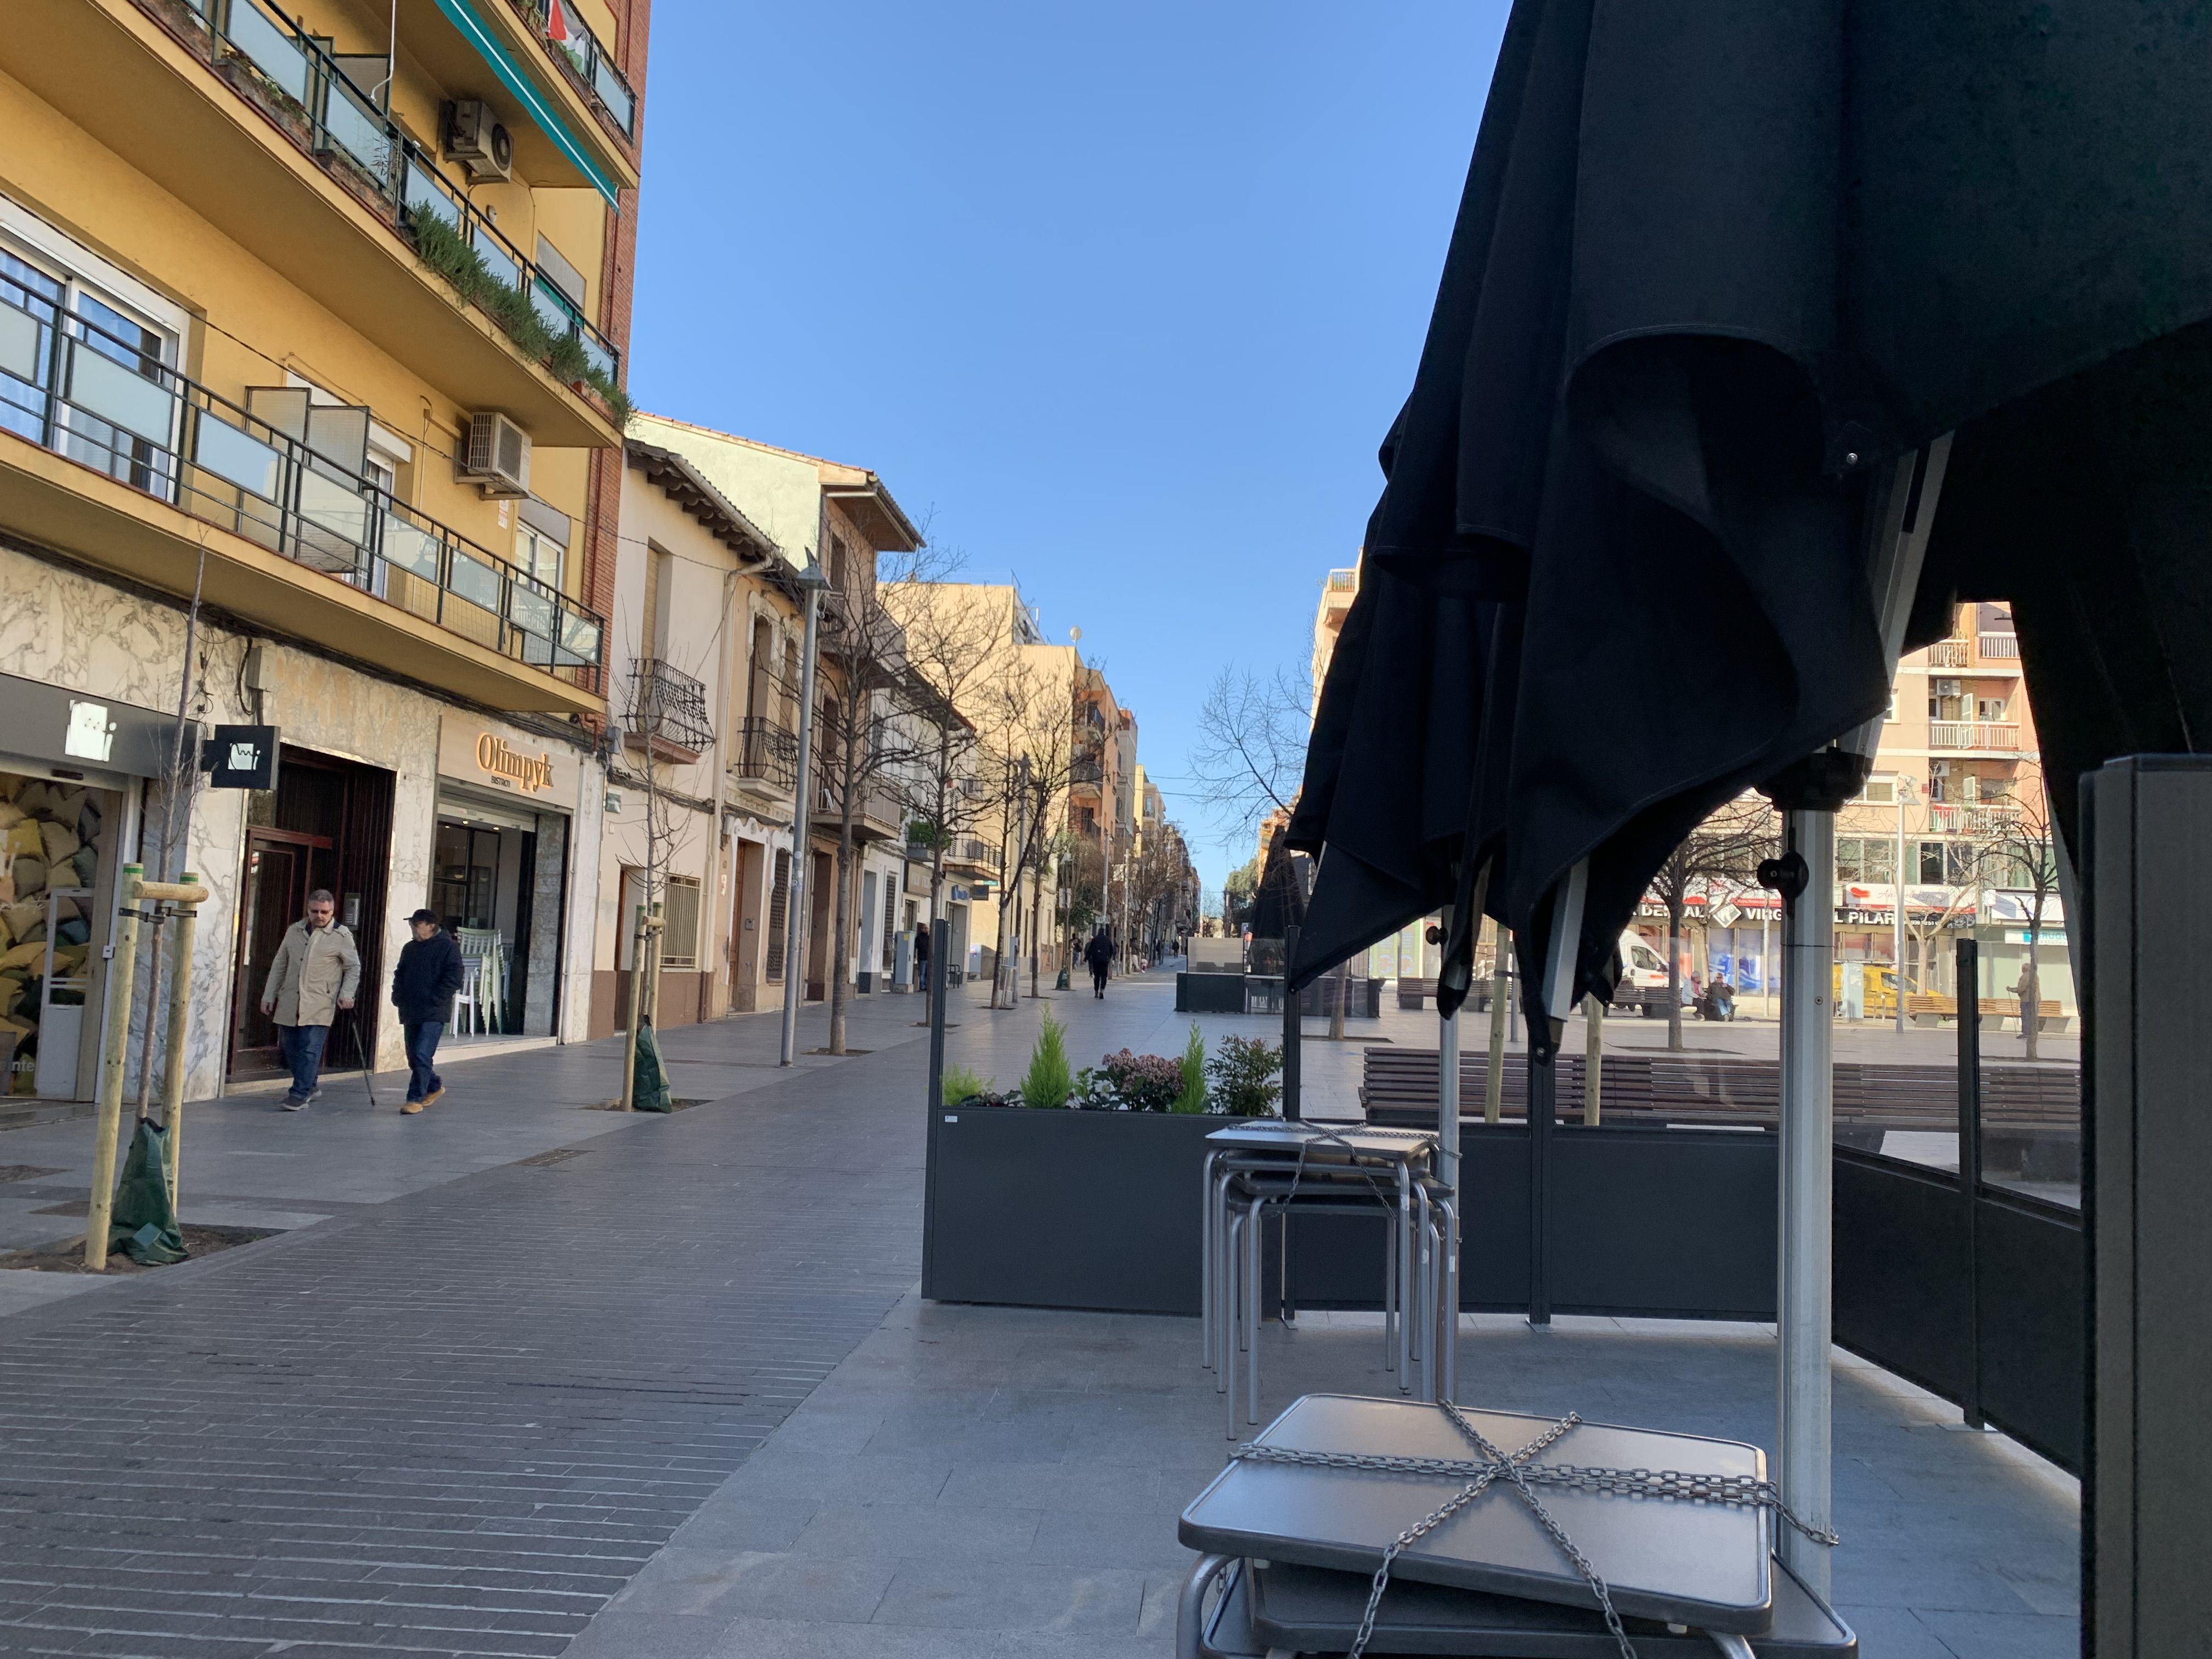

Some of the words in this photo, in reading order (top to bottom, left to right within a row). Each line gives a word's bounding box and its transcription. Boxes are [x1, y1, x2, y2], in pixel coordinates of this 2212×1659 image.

[479, 735, 554, 792] Olimpyk
[1641, 904, 1705, 918] DEAL
[1746, 907, 1782, 921] VIRG
[1848, 912, 1895, 925] PILAR
